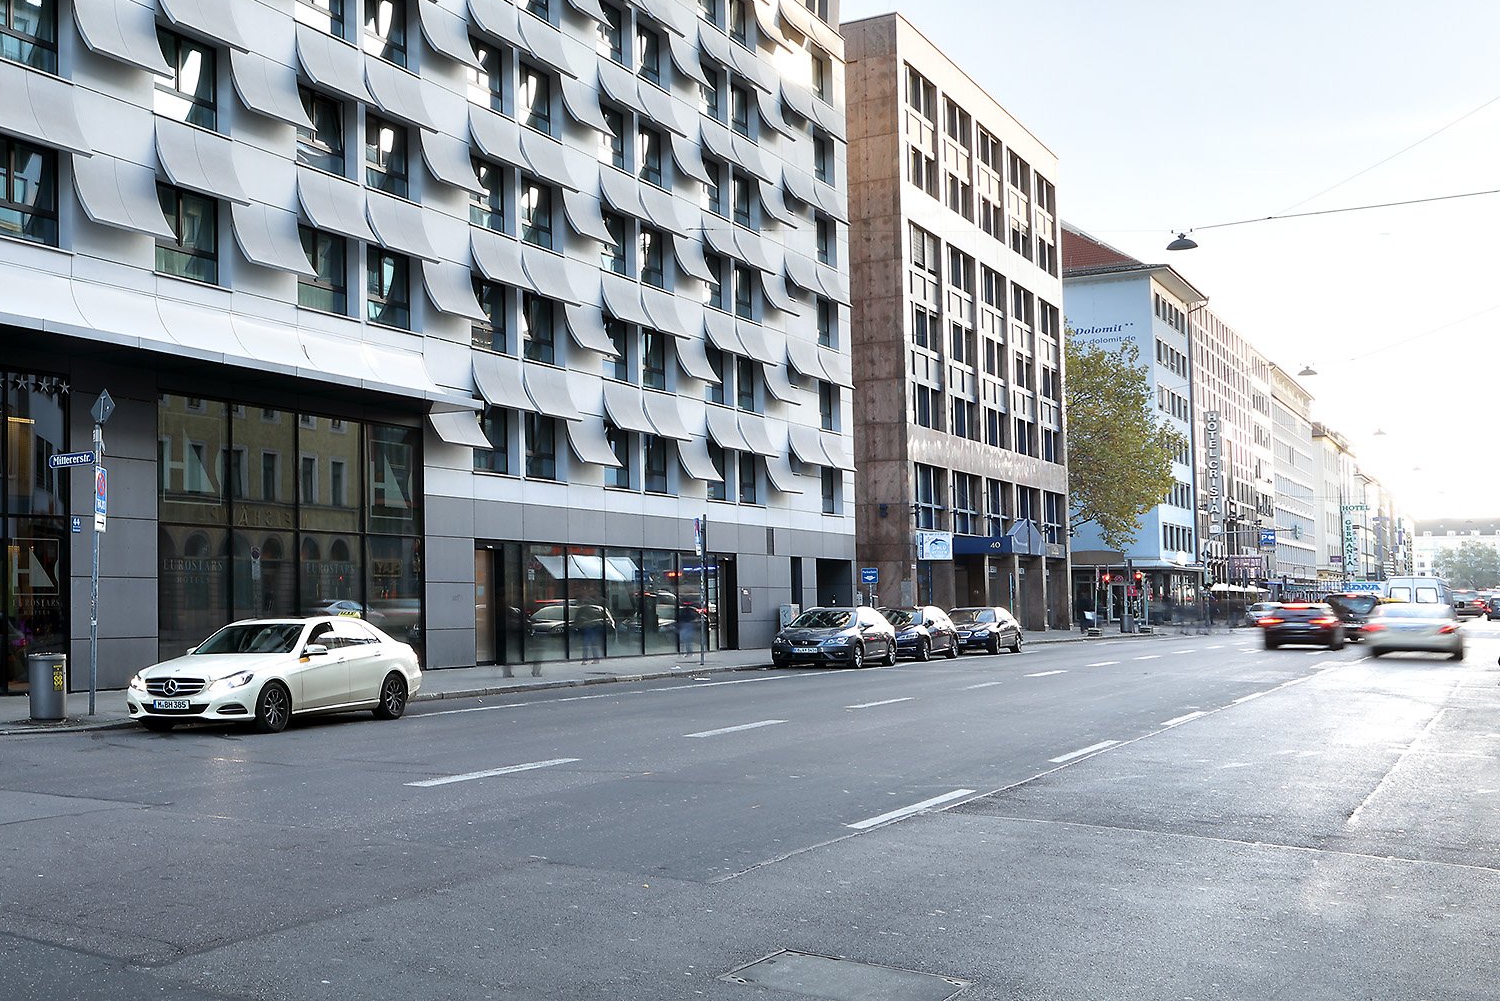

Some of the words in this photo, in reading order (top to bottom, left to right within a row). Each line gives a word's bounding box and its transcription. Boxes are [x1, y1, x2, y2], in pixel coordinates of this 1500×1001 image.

[1076, 324, 1122, 335] Dolomit
[1206, 413, 1218, 457] HOTEL
[1208, 460, 1220, 522] CRISTAL
[1345, 519, 1354, 566] GERMANIA
[162, 558, 224, 572] EUROSTARS
